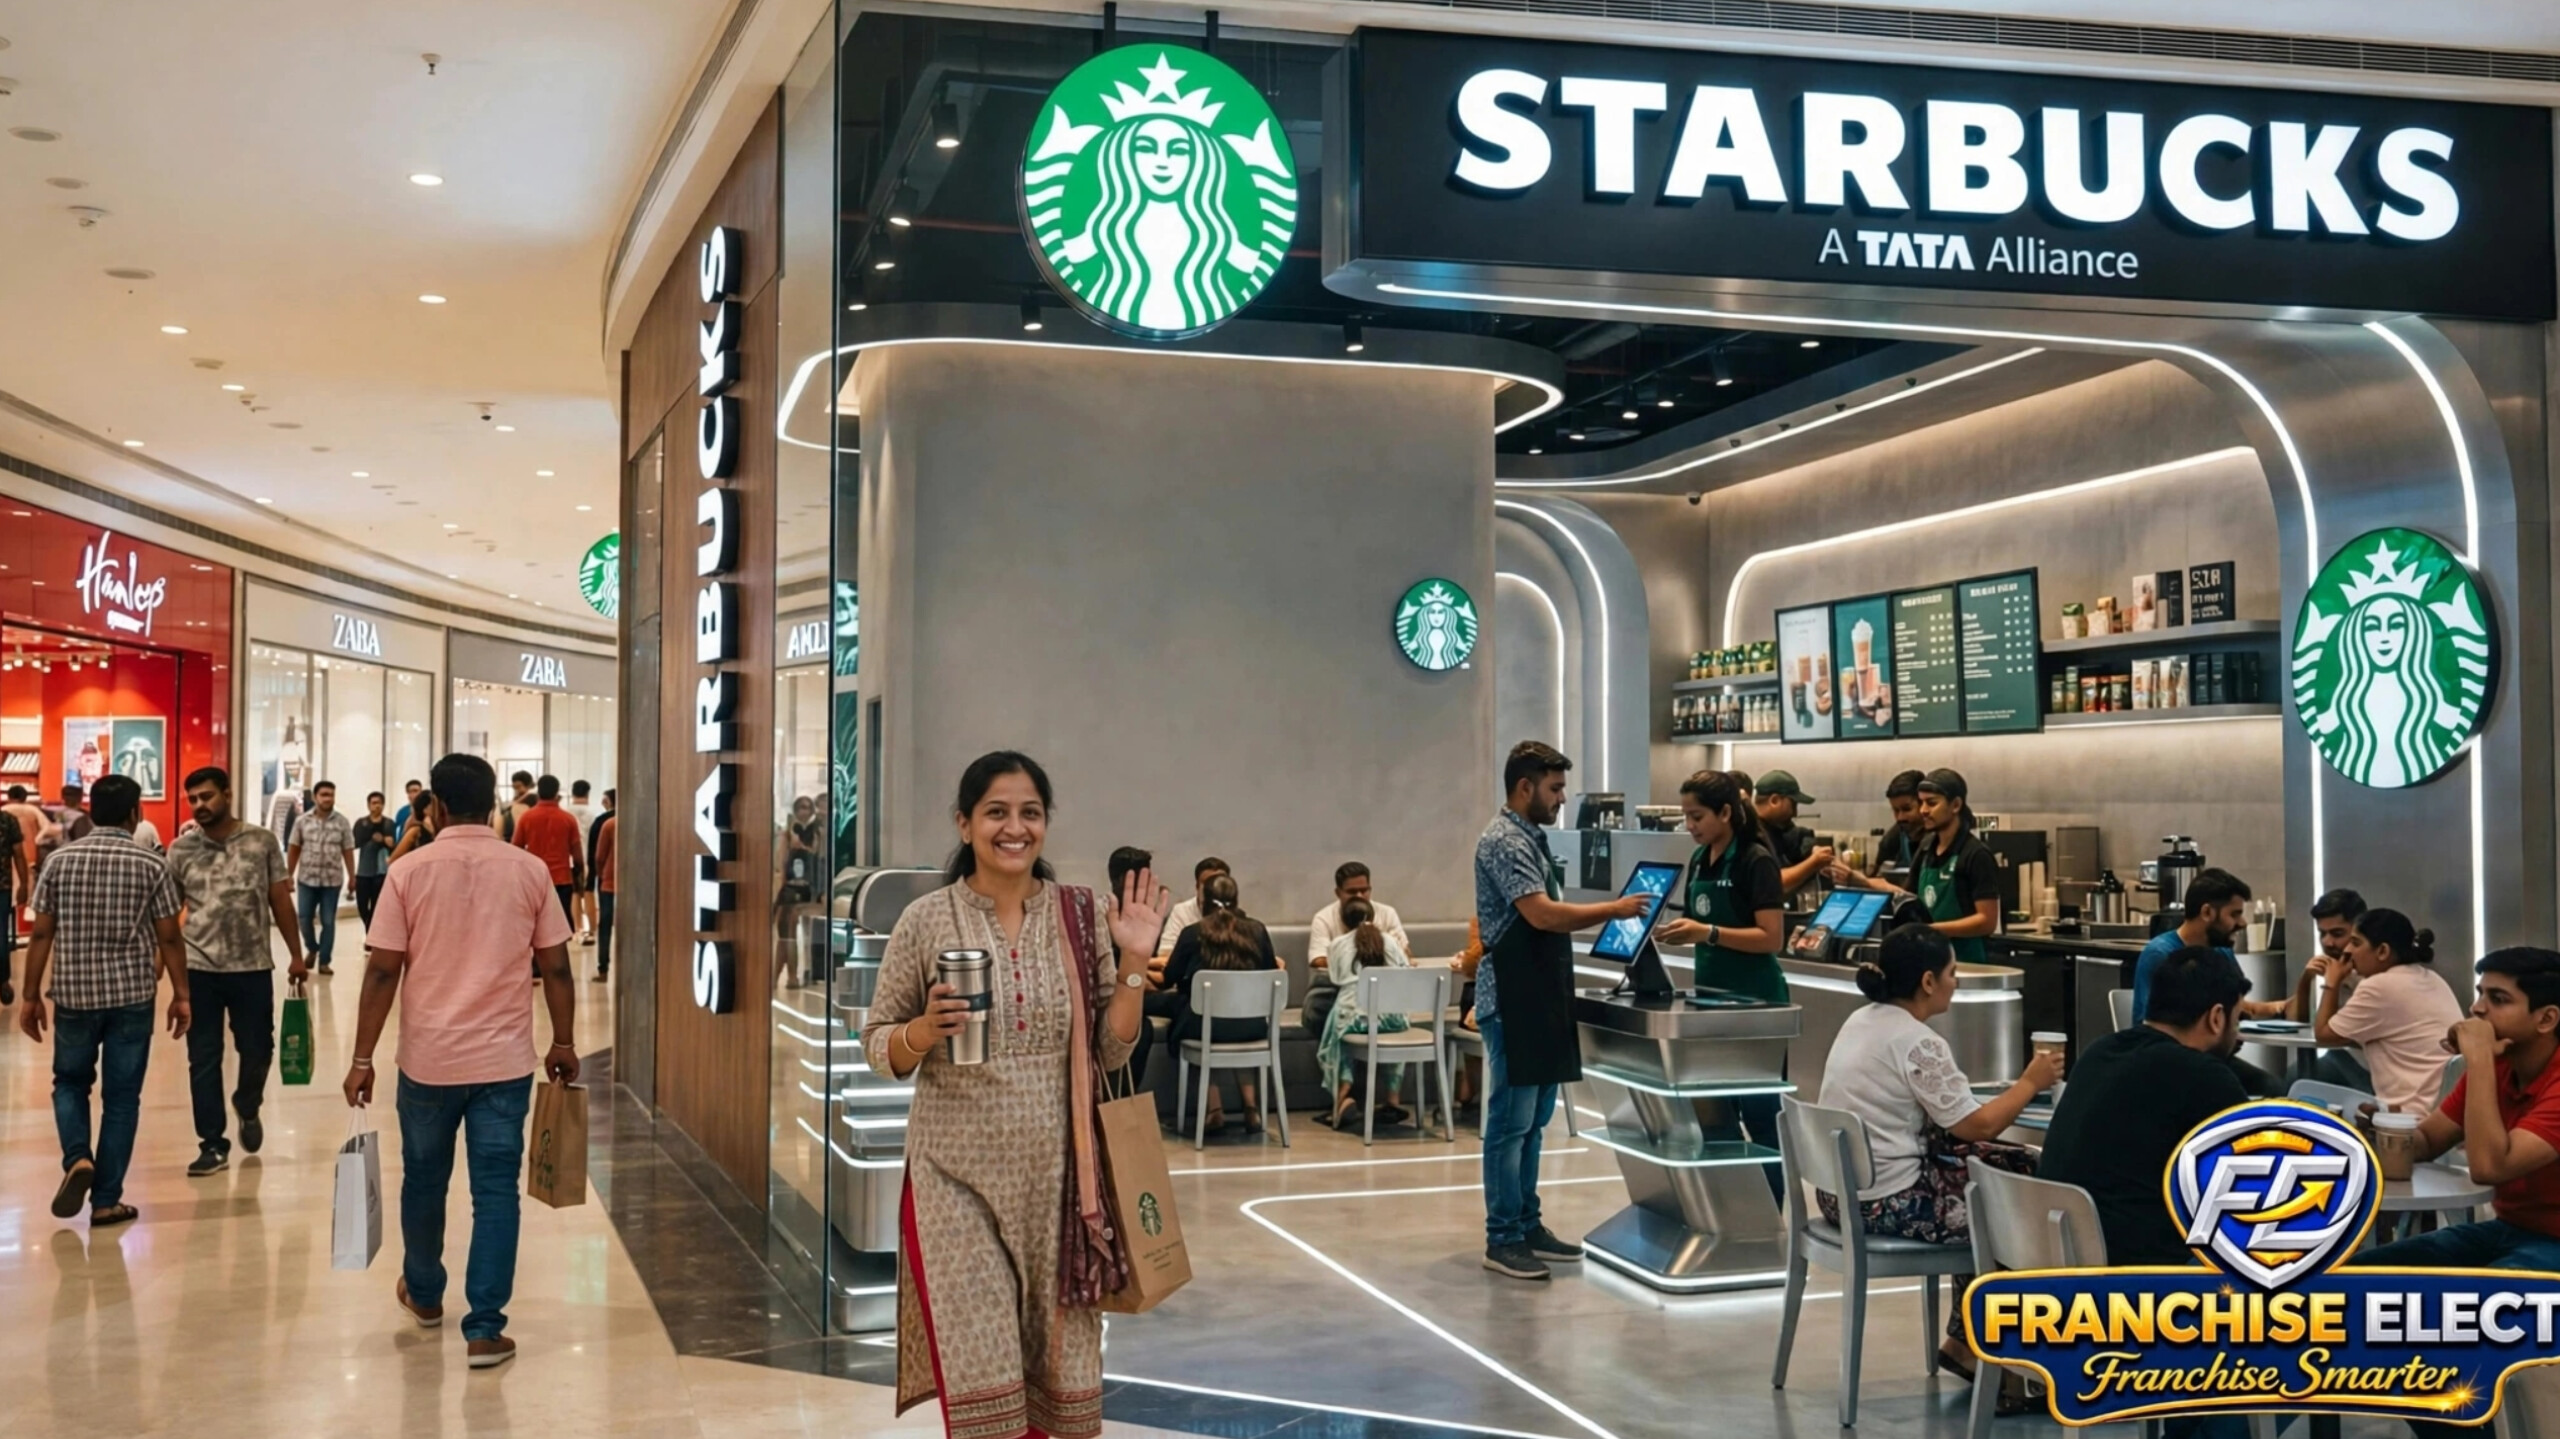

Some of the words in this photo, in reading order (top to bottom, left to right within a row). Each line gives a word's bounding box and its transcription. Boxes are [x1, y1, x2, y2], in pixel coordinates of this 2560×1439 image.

[1456, 69, 2458, 240] STARBUCKS
[1819, 228, 1849, 264] A
[1857, 230, 1975, 271] TATA
[1986, 236, 2139, 279] Alliance
[332, 613, 381, 657] ZARA
[693, 226, 726, 1013] STARBUCKS
[520, 652, 567, 688] ZARA
